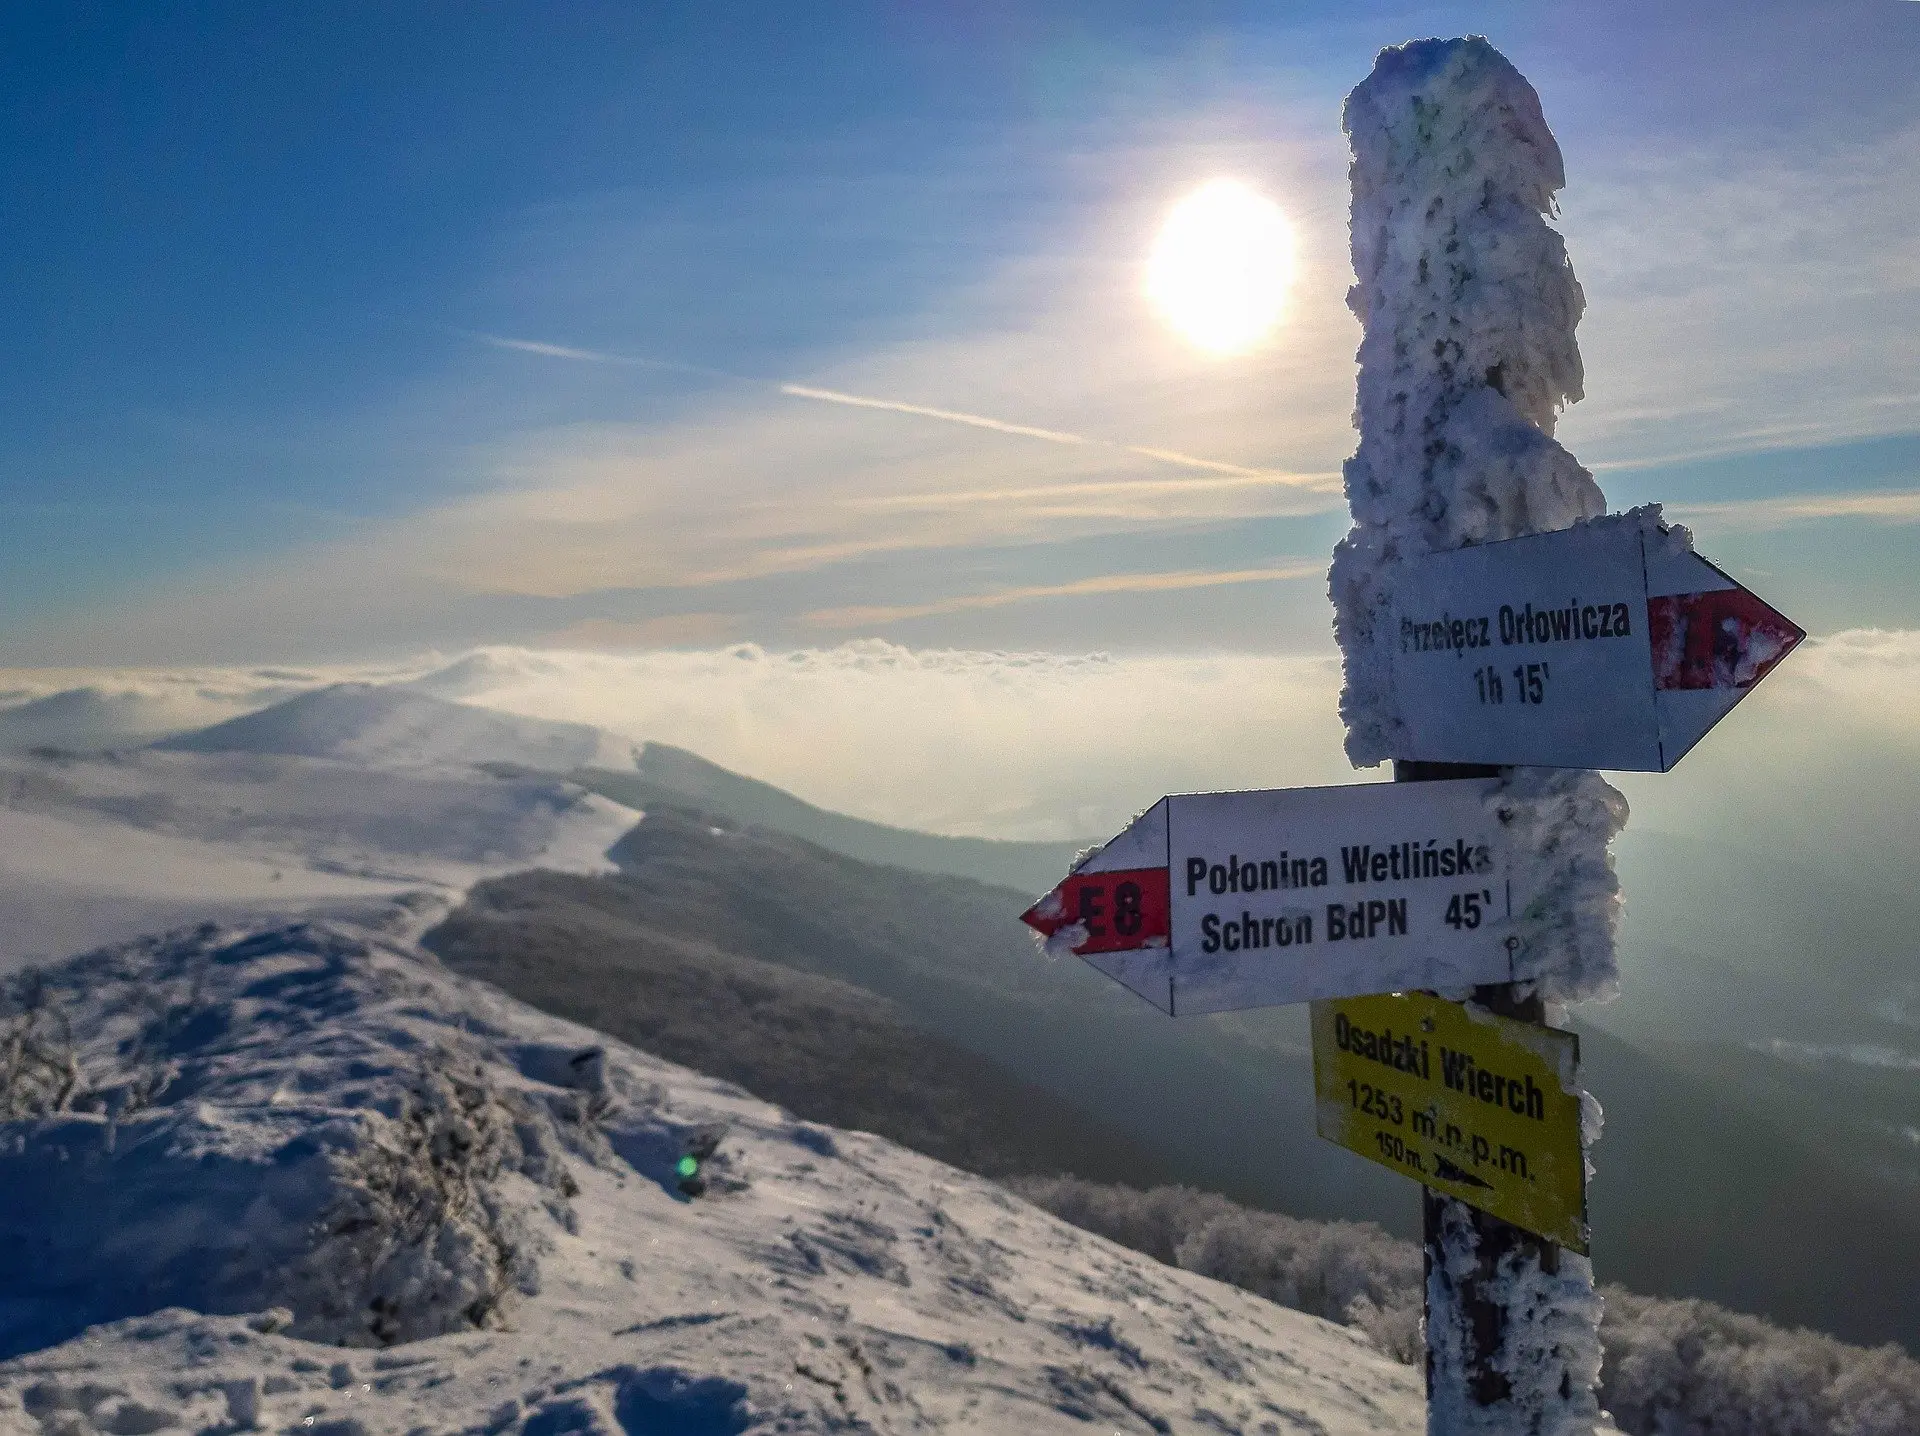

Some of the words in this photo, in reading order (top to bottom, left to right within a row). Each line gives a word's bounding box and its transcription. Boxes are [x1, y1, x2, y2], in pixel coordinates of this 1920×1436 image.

[1499, 597, 1631, 646] Orłowicza
[1474, 665, 1503, 704] 1h
[1513, 662, 1550, 704] 15'
[1186, 850, 1328, 896] Połonina
[1079, 882, 1143, 937] E8
[1326, 898, 1407, 942] BdPN
[1445, 889, 1491, 930] 45'
[1335, 1011, 1429, 1081] Osadzki
[1440, 1046, 1544, 1122] Wierch
[1347, 1078, 1404, 1126] 1253
